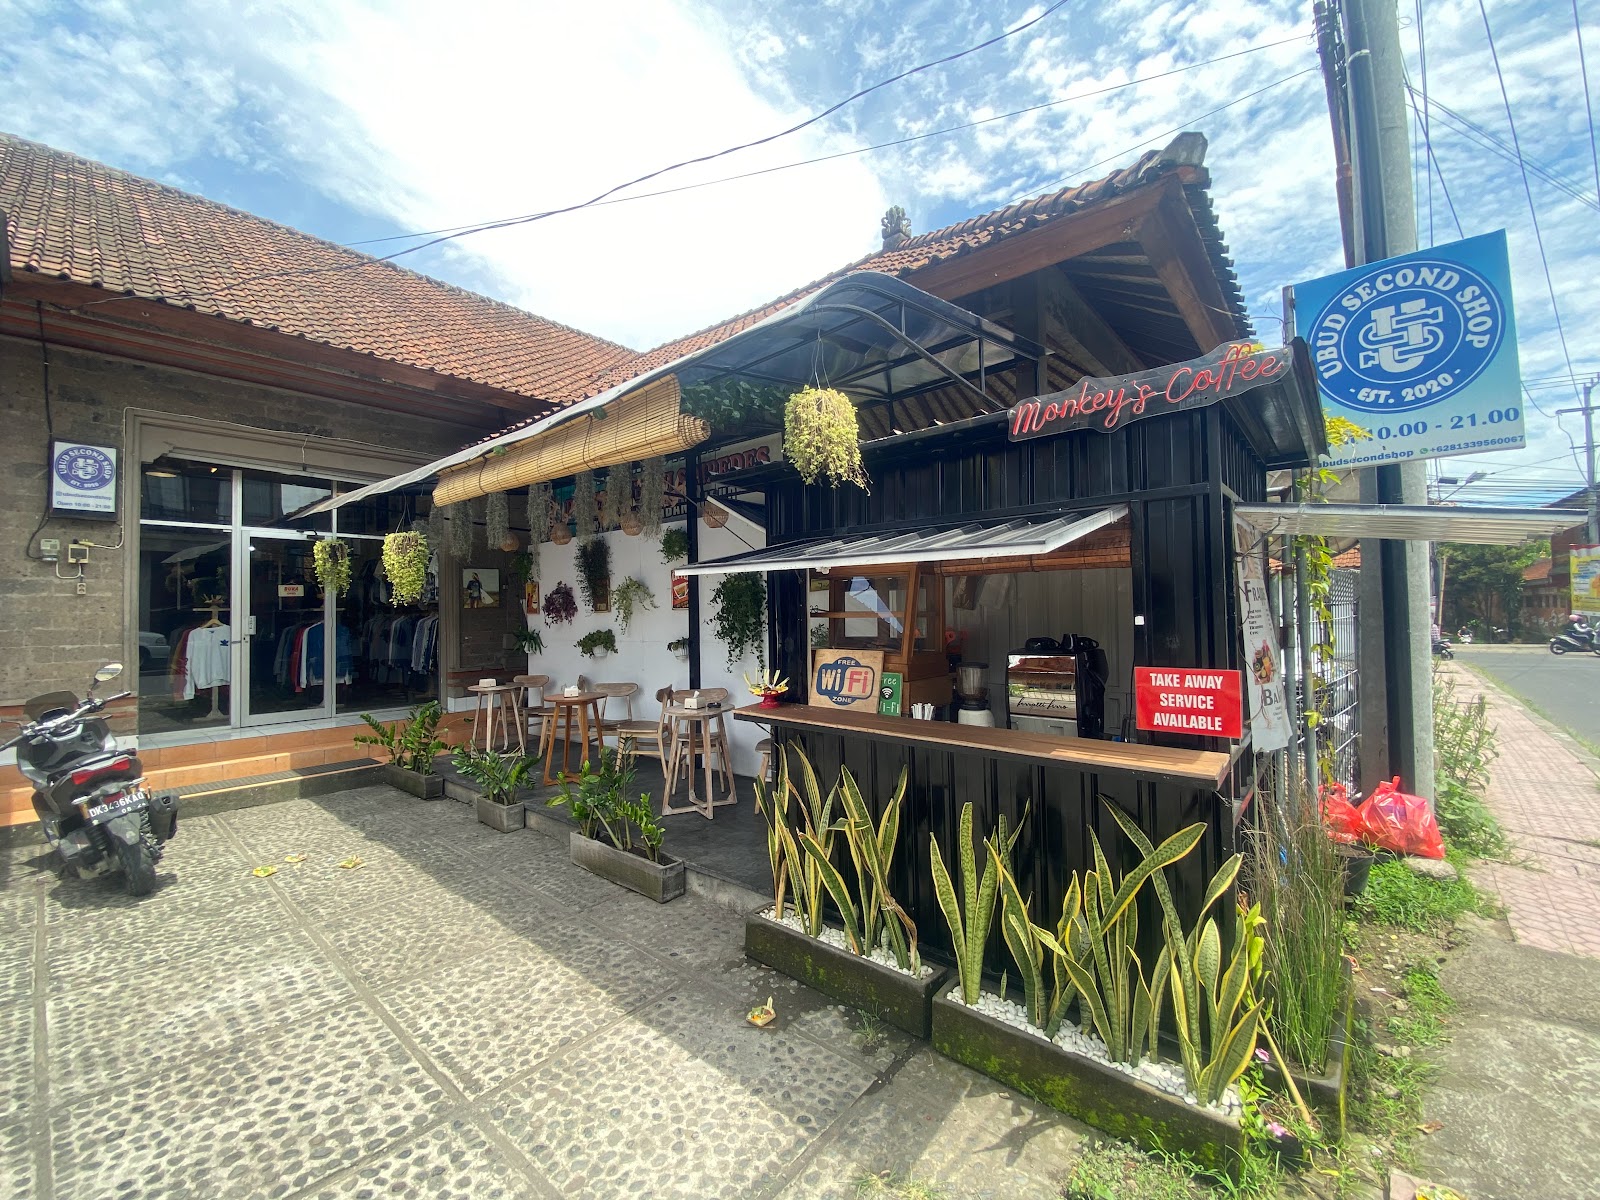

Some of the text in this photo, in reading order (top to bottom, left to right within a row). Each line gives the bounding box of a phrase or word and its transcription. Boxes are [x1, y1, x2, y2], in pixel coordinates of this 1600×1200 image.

[1316, 266, 1493, 380] UBUD SECOND SHOP
[1012, 342, 1285, 435] Monkey's Coffee
[1402, 373, 1454, 402] 2020
[1450, 407, 1520, 430] 21.00
[1149, 673, 1224, 690] TAKE AWAY
[832, 696, 853, 704] ZONE
[1159, 693, 1214, 709] SERVICE
[1153, 712, 1223, 731] AVAILABLE
